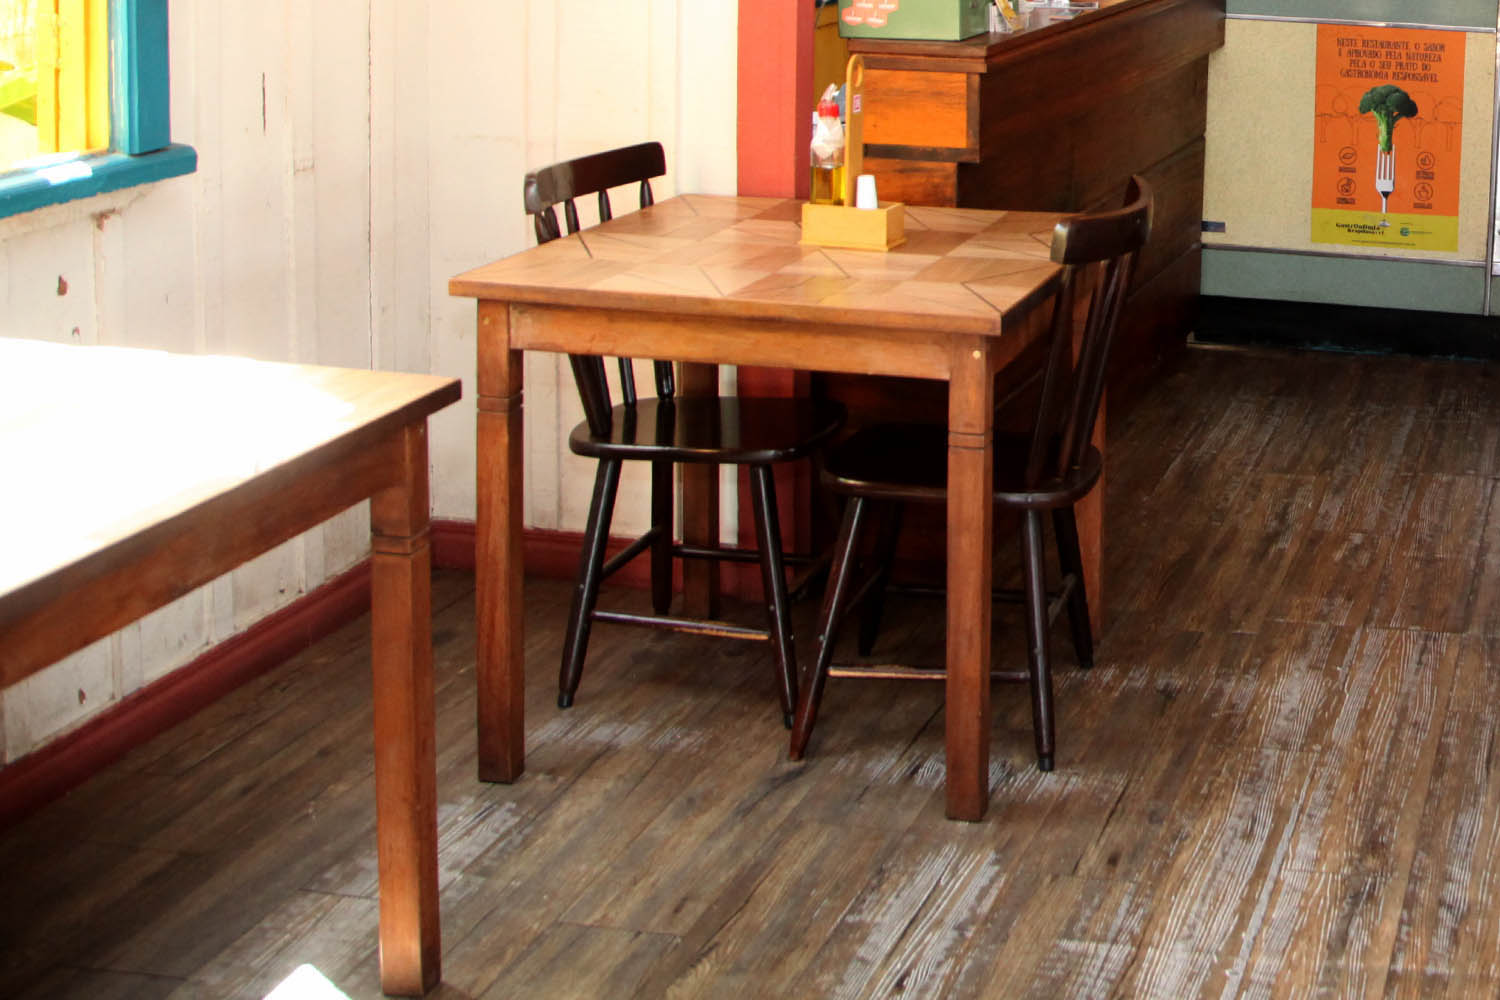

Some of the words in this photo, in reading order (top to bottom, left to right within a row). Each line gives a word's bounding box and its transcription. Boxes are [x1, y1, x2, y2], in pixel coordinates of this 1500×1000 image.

[1361, 39, 1410, 51] RESTAURANTE
[1423, 42, 1446, 53] SABOR
[1346, 49, 1382, 59] APROVADO
[1384, 50, 1402, 60] PELA
[1405, 51, 1442, 63] NATUREZA
[1395, 61, 1418, 72] PRATO
